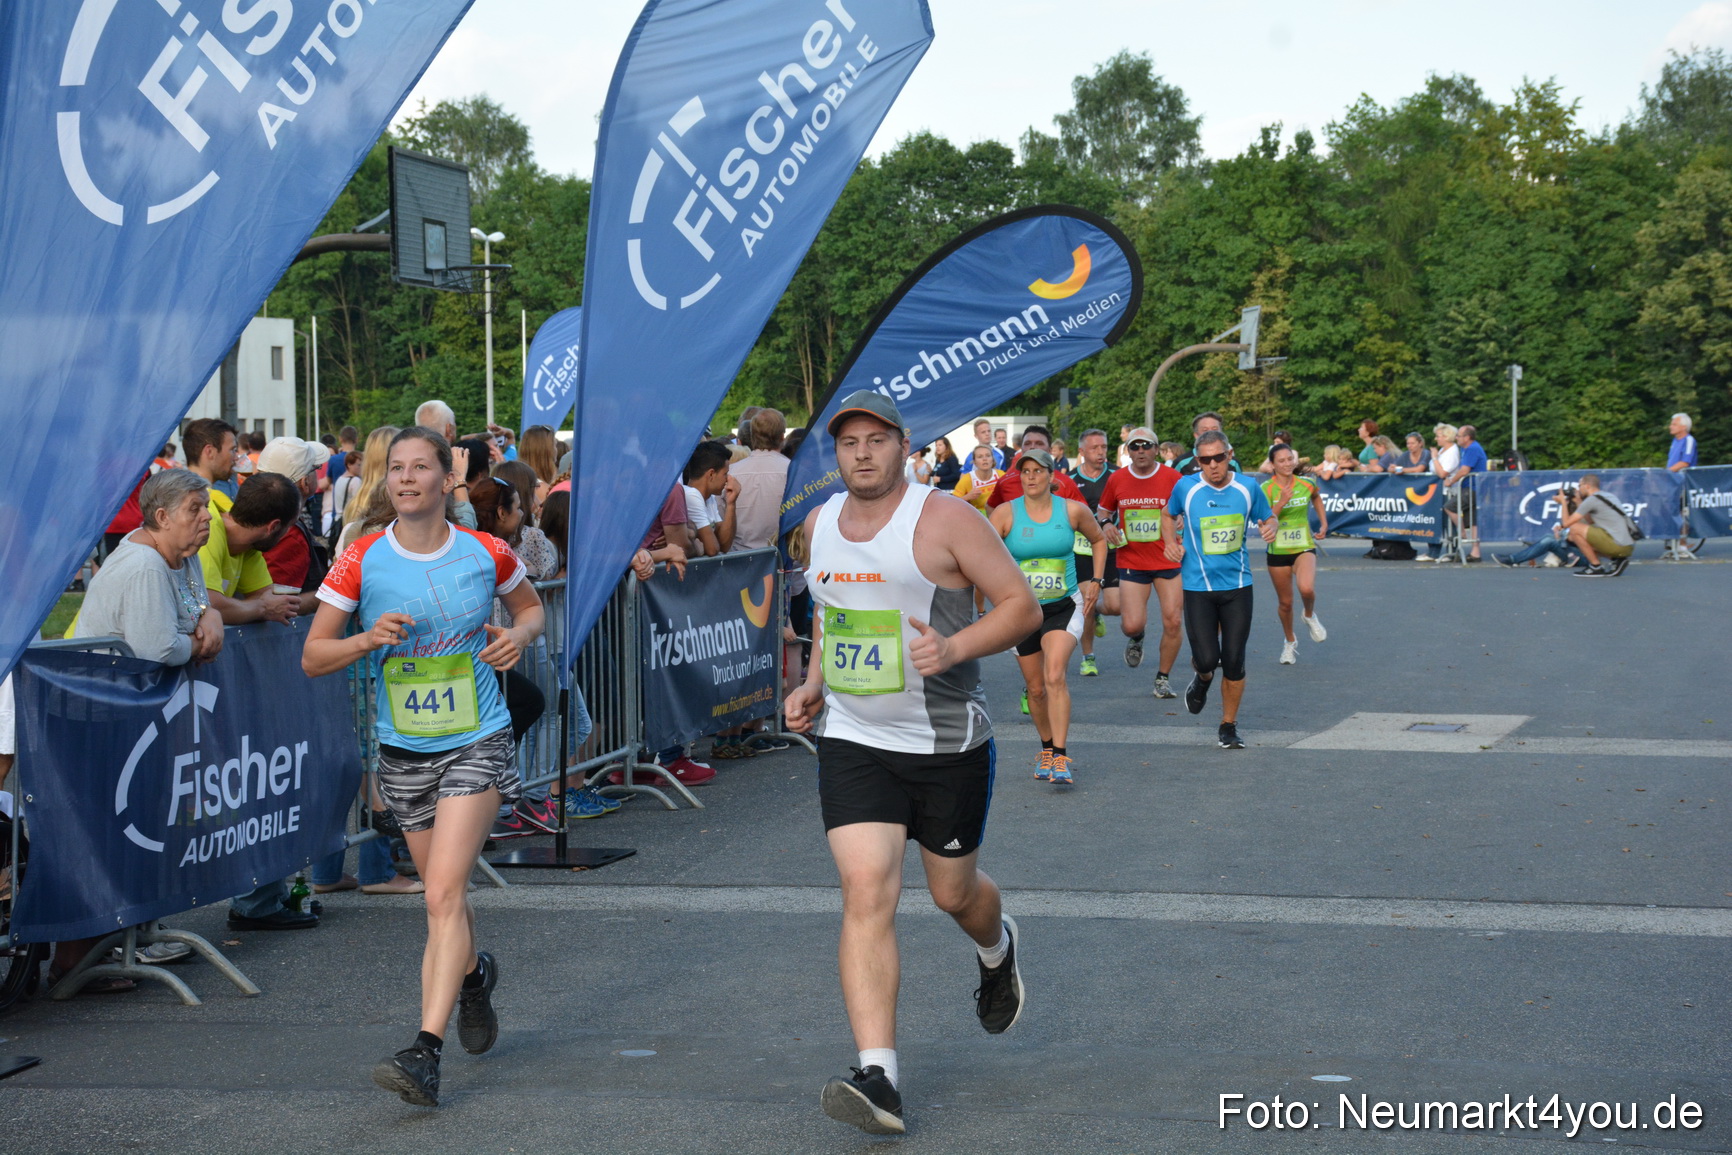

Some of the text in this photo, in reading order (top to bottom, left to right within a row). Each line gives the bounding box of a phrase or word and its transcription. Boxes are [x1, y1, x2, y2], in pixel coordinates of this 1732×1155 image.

[672, 0, 857, 262] Fischer
[739, 33, 879, 258] AUTOMOBILE
[976, 292, 1121, 376] Druck und Medien
[841, 304, 1050, 405] ischmann
[1119, 497, 1159, 506] NEUMARKT
[1312, 493, 1408, 512] Frischmann
[1129, 522, 1157, 533] 1404
[1368, 513, 1435, 524] Druck und Medien
[1077, 537, 1092, 549] 13
[1211, 529, 1236, 544] 523
[1283, 530, 1302, 541] 146
[834, 573, 886, 583] KLEBL
[1026, 575, 1063, 590] 1295
[650, 615, 749, 670] Frischmann
[712, 660, 735, 686] Druck
[736, 654, 752, 680] und
[835, 643, 884, 671] 574
[405, 687, 456, 715] 441
[167, 735, 309, 827] Fischer
[179, 805, 300, 868] AUTOMOBILE
